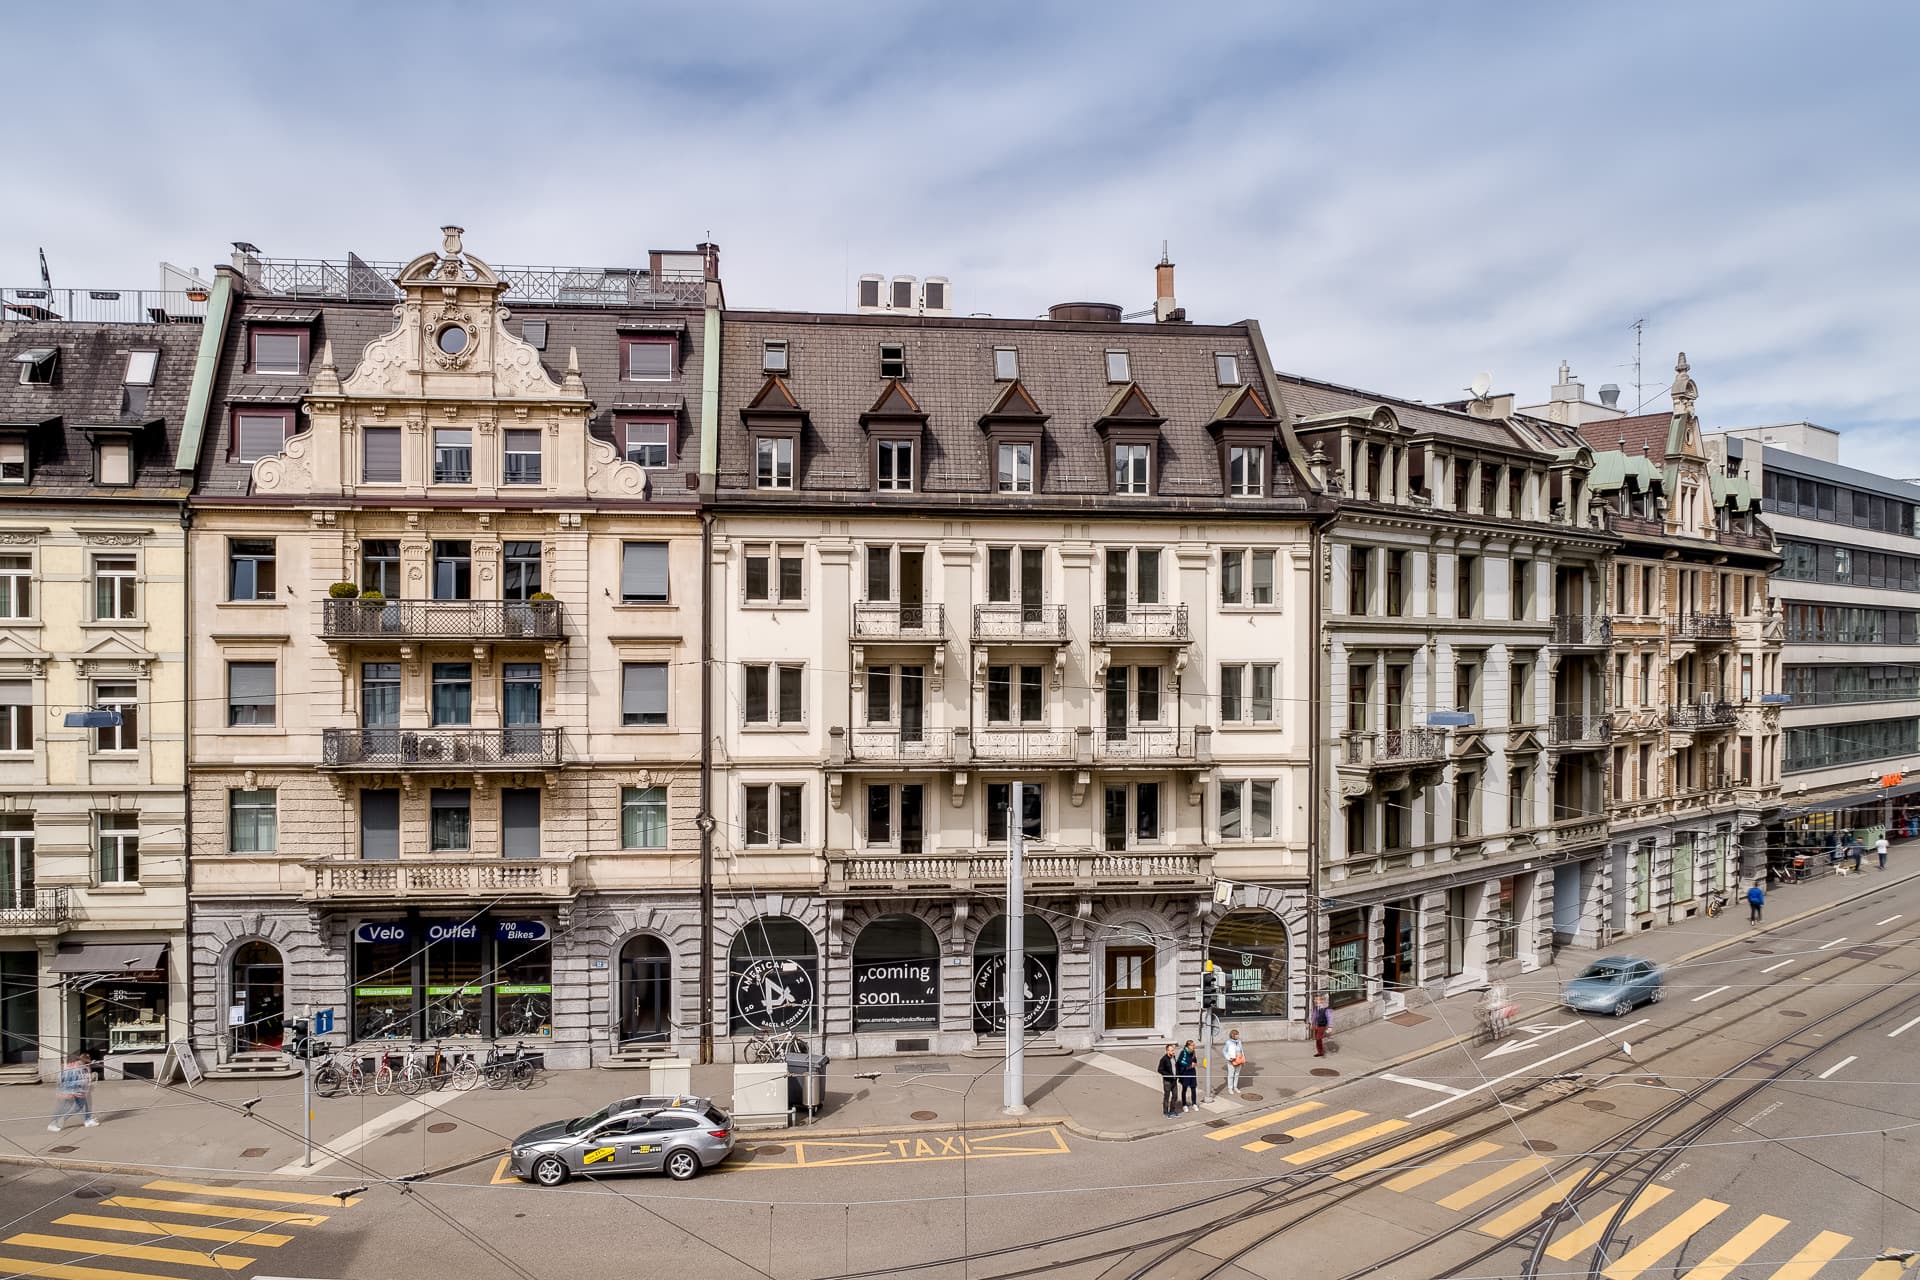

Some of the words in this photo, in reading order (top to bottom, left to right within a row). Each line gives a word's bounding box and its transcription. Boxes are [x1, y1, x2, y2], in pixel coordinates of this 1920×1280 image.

[369, 926, 405, 939] Velo
[429, 925, 477, 939] Outlet
[500, 922, 517, 930] 700
[507, 930, 535, 939] Bikes
[889, 1135, 972, 1158] TAXI
